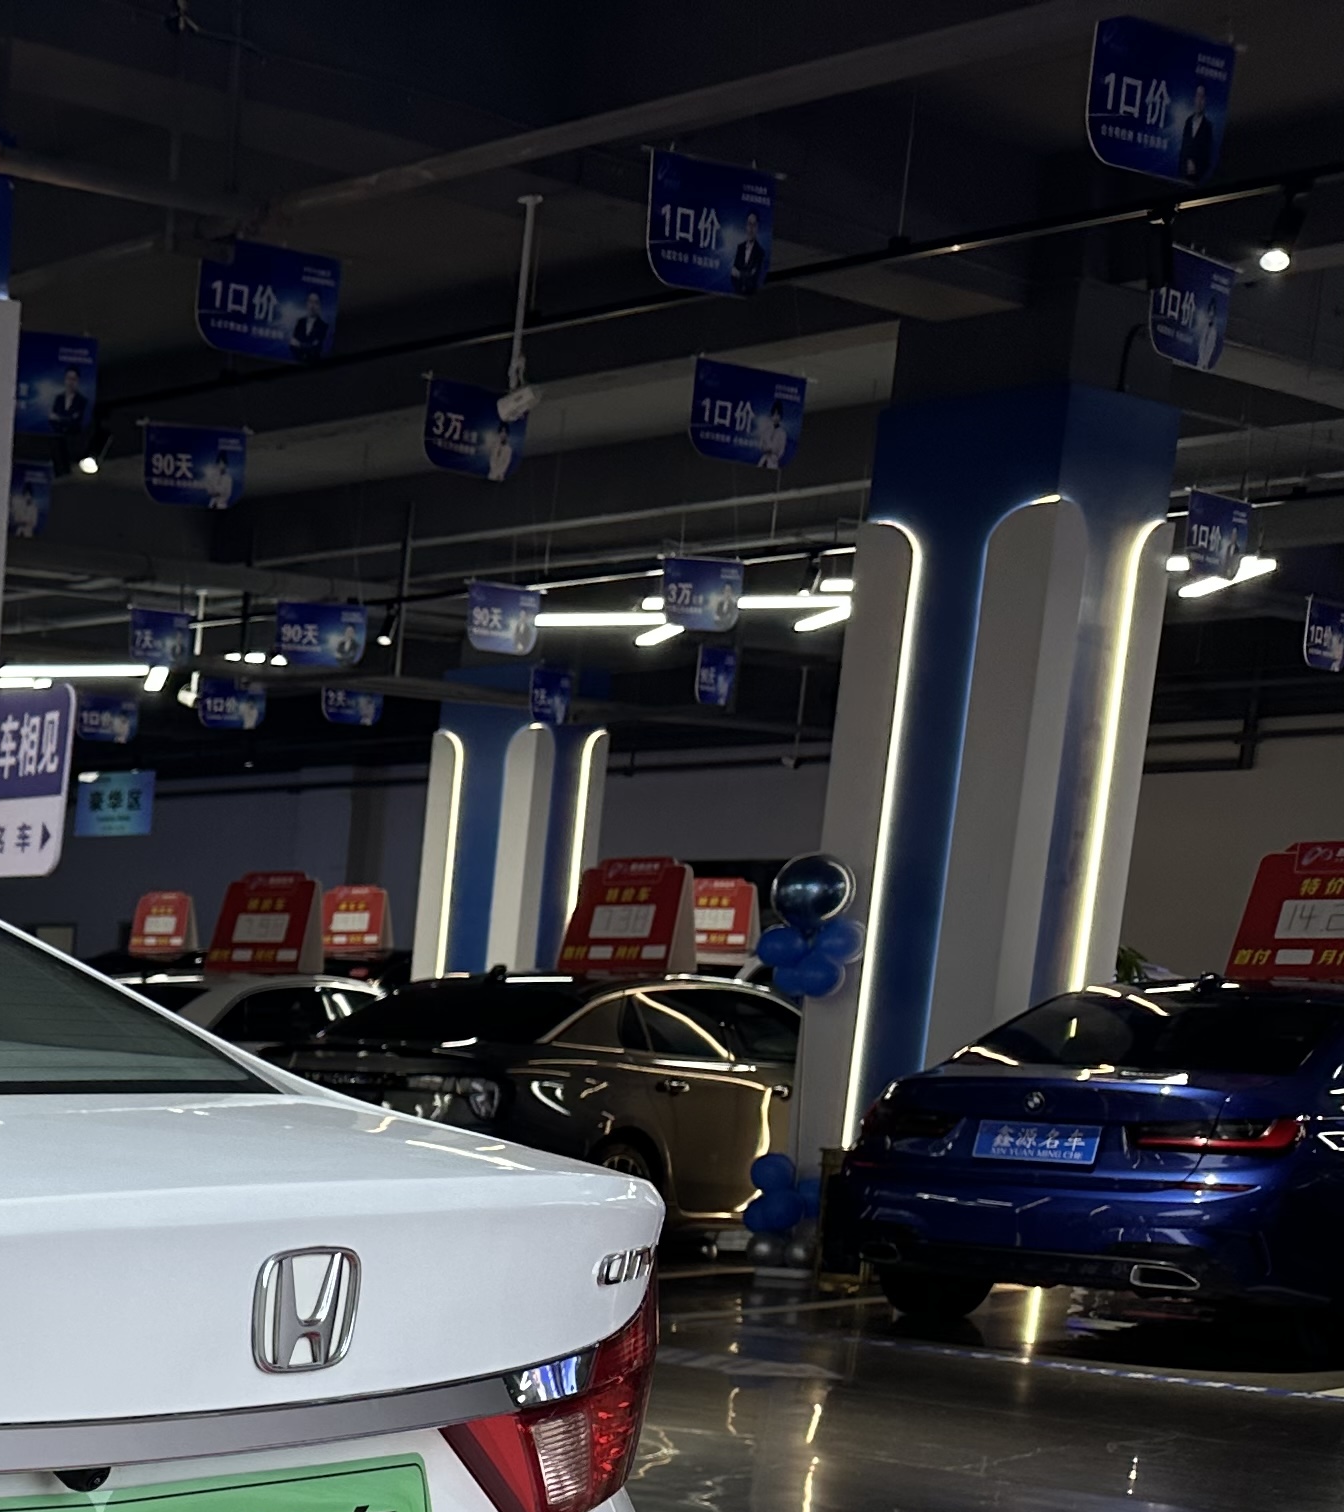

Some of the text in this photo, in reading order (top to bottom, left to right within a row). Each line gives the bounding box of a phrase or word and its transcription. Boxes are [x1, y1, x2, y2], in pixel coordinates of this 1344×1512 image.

[1103, 72, 1171, 129] 1口价
[660, 203, 721, 251] 1口价
[211, 279, 279, 322] 1口价
[1159, 286, 1197, 329] 1口价
[701, 397, 756, 434] 1口价
[151, 452, 194, 481] 90天
[1191, 523, 1222, 553] 1口价
[281, 623, 320, 646] 90天
[990, 1124, 1086, 1152] 鑫源名车
